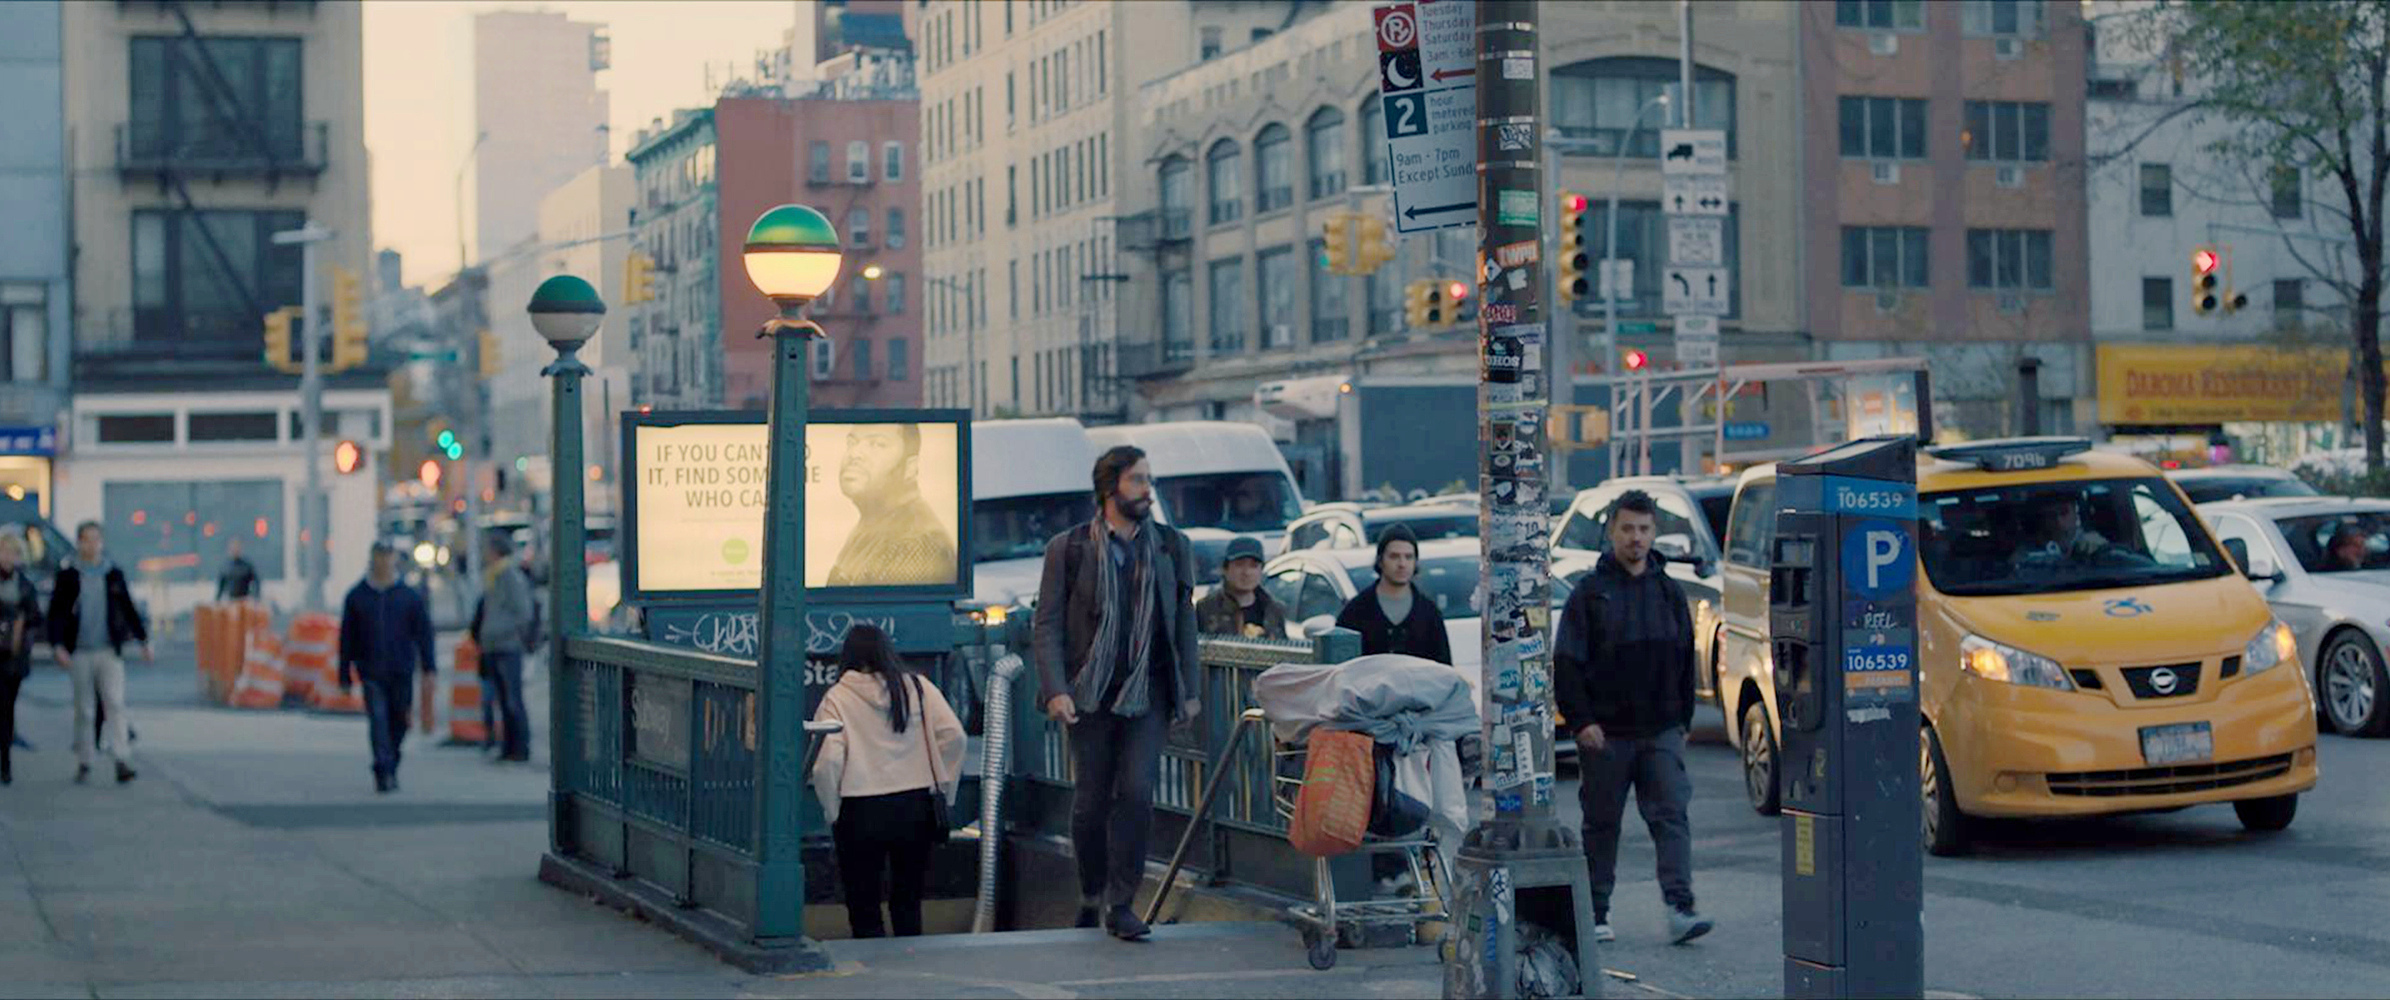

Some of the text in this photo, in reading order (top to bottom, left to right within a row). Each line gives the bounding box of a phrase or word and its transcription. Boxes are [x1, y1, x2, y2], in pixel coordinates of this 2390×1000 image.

[1423, 17, 1471, 32] Thursday
[1425, 32, 1471, 46] Saturday
[1395, 97, 1417, 134] 2
[1396, 153, 1422, 167] 9am
[1435, 148, 1460, 162] 7pm
[1398, 160, 1475, 184] Except Sund
[657, 444, 673, 463] IF
[678, 444, 718, 462] YOU
[648, 467, 669, 487] IT,
[676, 467, 720, 485] FIND
[685, 489, 766, 508] WHO CA
[1838, 491, 1904, 509] 106539
[1866, 530, 1901, 588] P
[1847, 653, 1908, 671] 106539
